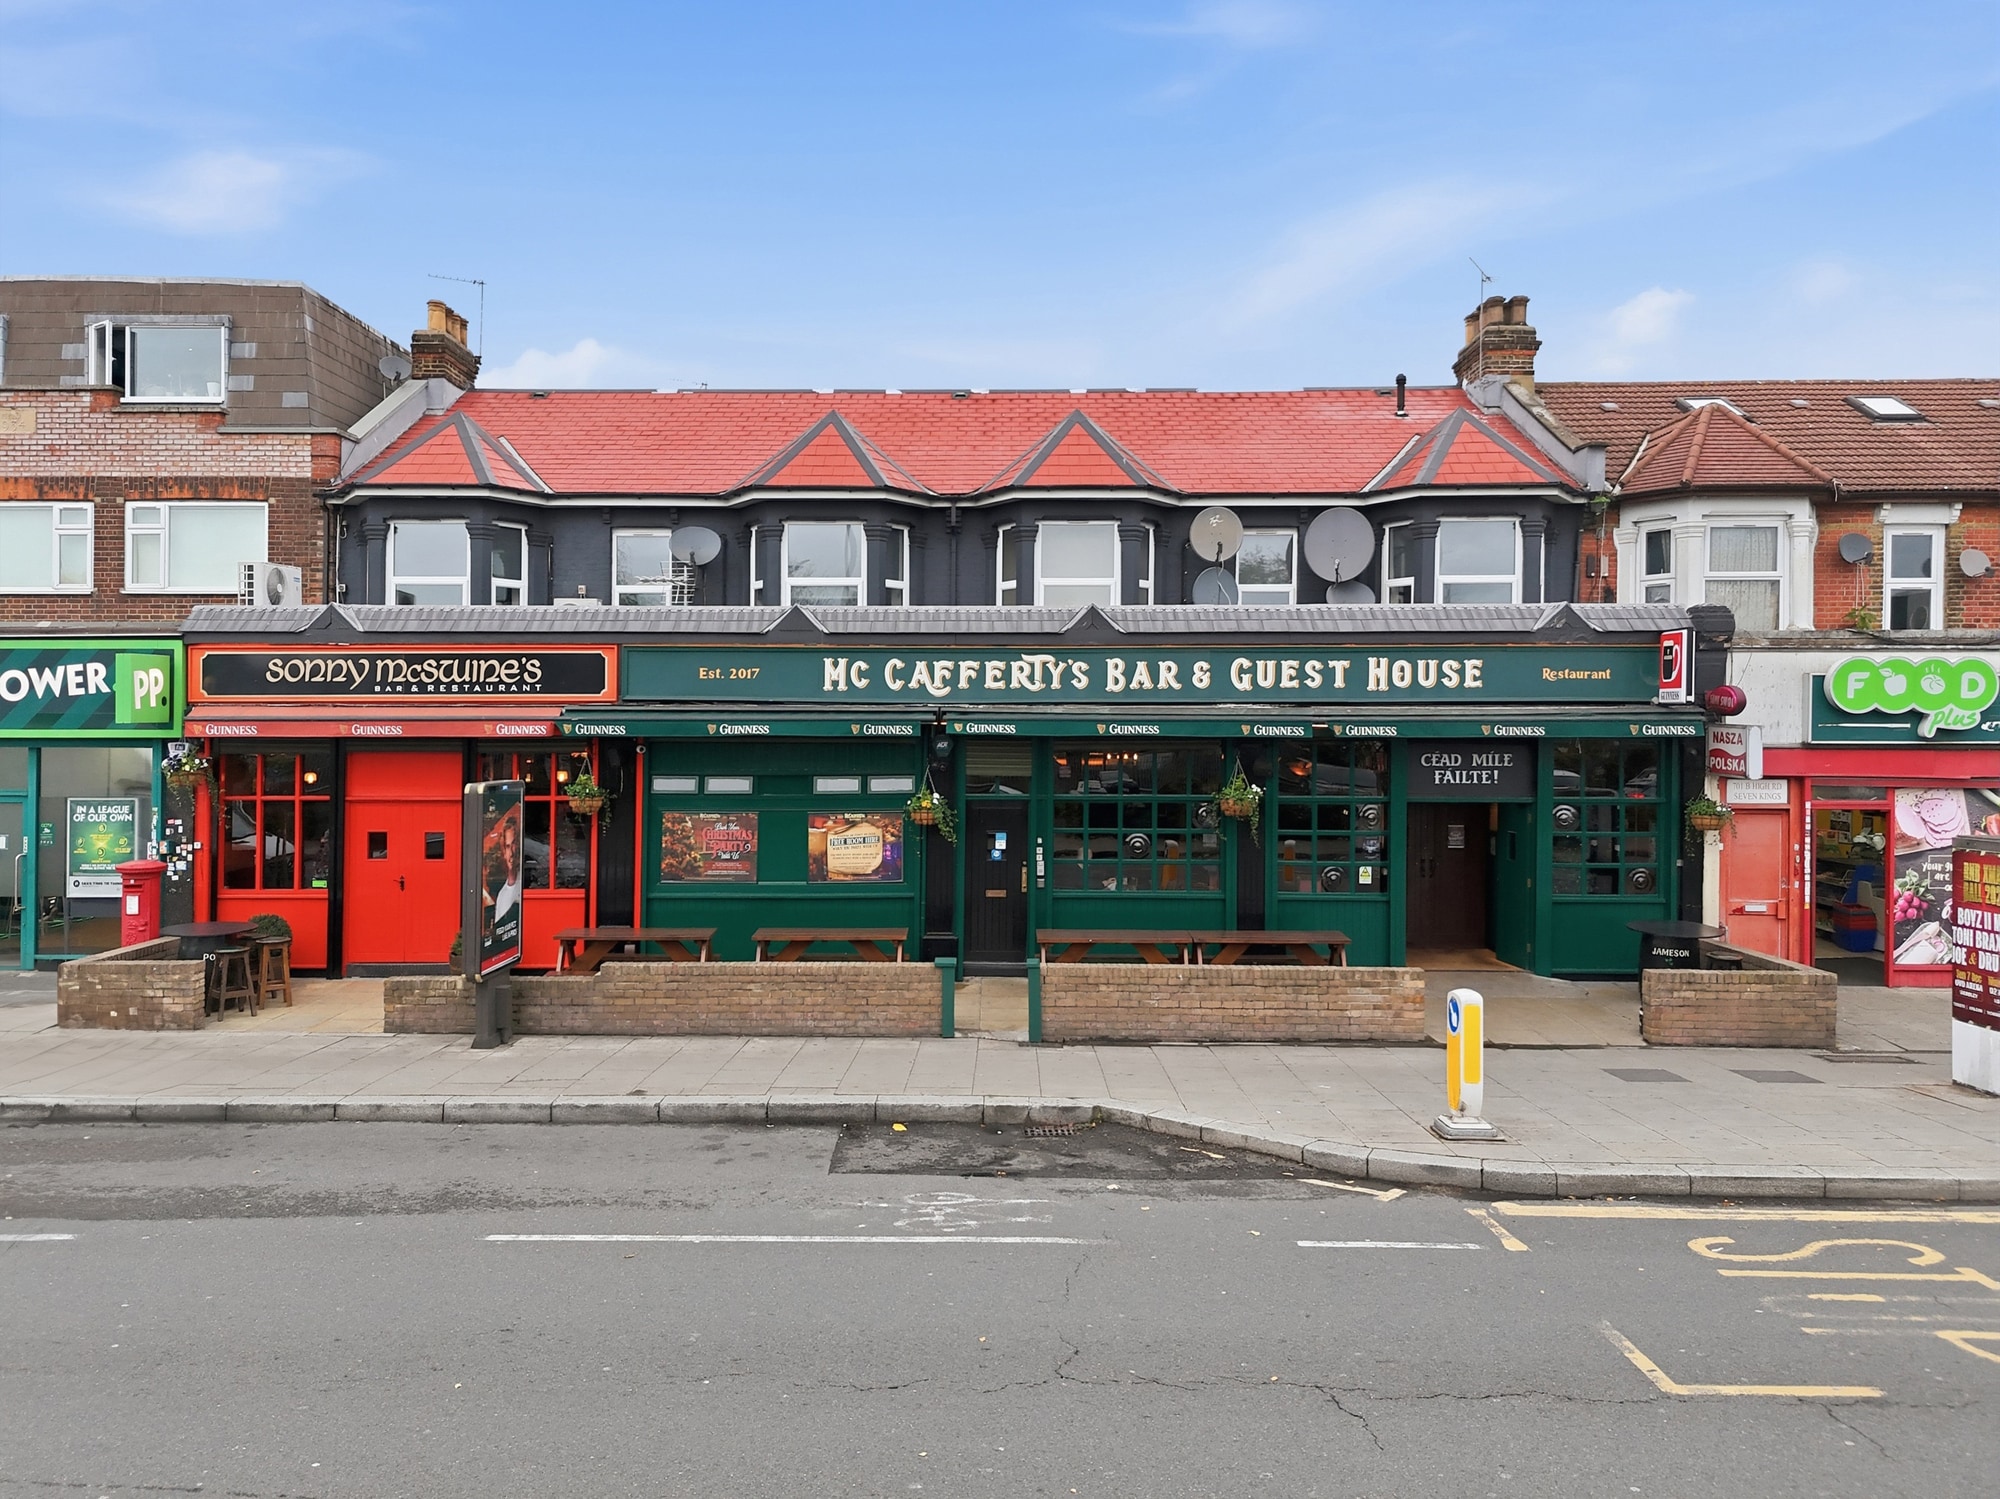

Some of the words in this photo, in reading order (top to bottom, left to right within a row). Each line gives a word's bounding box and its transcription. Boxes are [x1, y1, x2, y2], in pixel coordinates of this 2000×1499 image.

[699, 667, 725, 680] Est.
[729, 667, 760, 680] 2017
[1192, 660, 1211, 689] &
[1542, 667, 1611, 682] Restaurant
[410, 684, 419, 692] &
[427, 684, 542, 692] RESTAURANT
[1927, 708, 1977, 735] plus
[205, 724, 257, 735] GUINNESS
[351, 724, 402, 735] GUINNESS
[496, 724, 547, 735] GUINNESS
[575, 724, 626, 735] GUINNESS
[719, 724, 770, 735] GUINNESS
[863, 724, 913, 735] GUINNESS
[966, 723, 1016, 734] GUINNESS
[1109, 724, 1160, 735] GUINNESS
[1253, 725, 1304, 736] GUINNESS
[1346, 725, 1397, 736] GUINNESS
[1494, 725, 1545, 736] GUINNESS
[1642, 725, 1696, 736] GUINNESS
[1712, 731, 1743, 745] NASZA
[1709, 757, 1746, 772] POLSKA
[76, 805, 87, 814] IN
[88, 805, 96, 814] A
[98, 805, 130, 814] LEAGUE
[73, 813, 85, 822] OF
[87, 813, 107, 822] OUR
[109, 813, 133, 822] OWN
[1957, 906, 1983, 929] BOYZ
[1952, 925, 1974, 947] TONI
[1651, 947, 1690, 957] JAMESON
[1952, 945, 1967, 966] JOE
[1978, 950, 1999, 973] DRU
